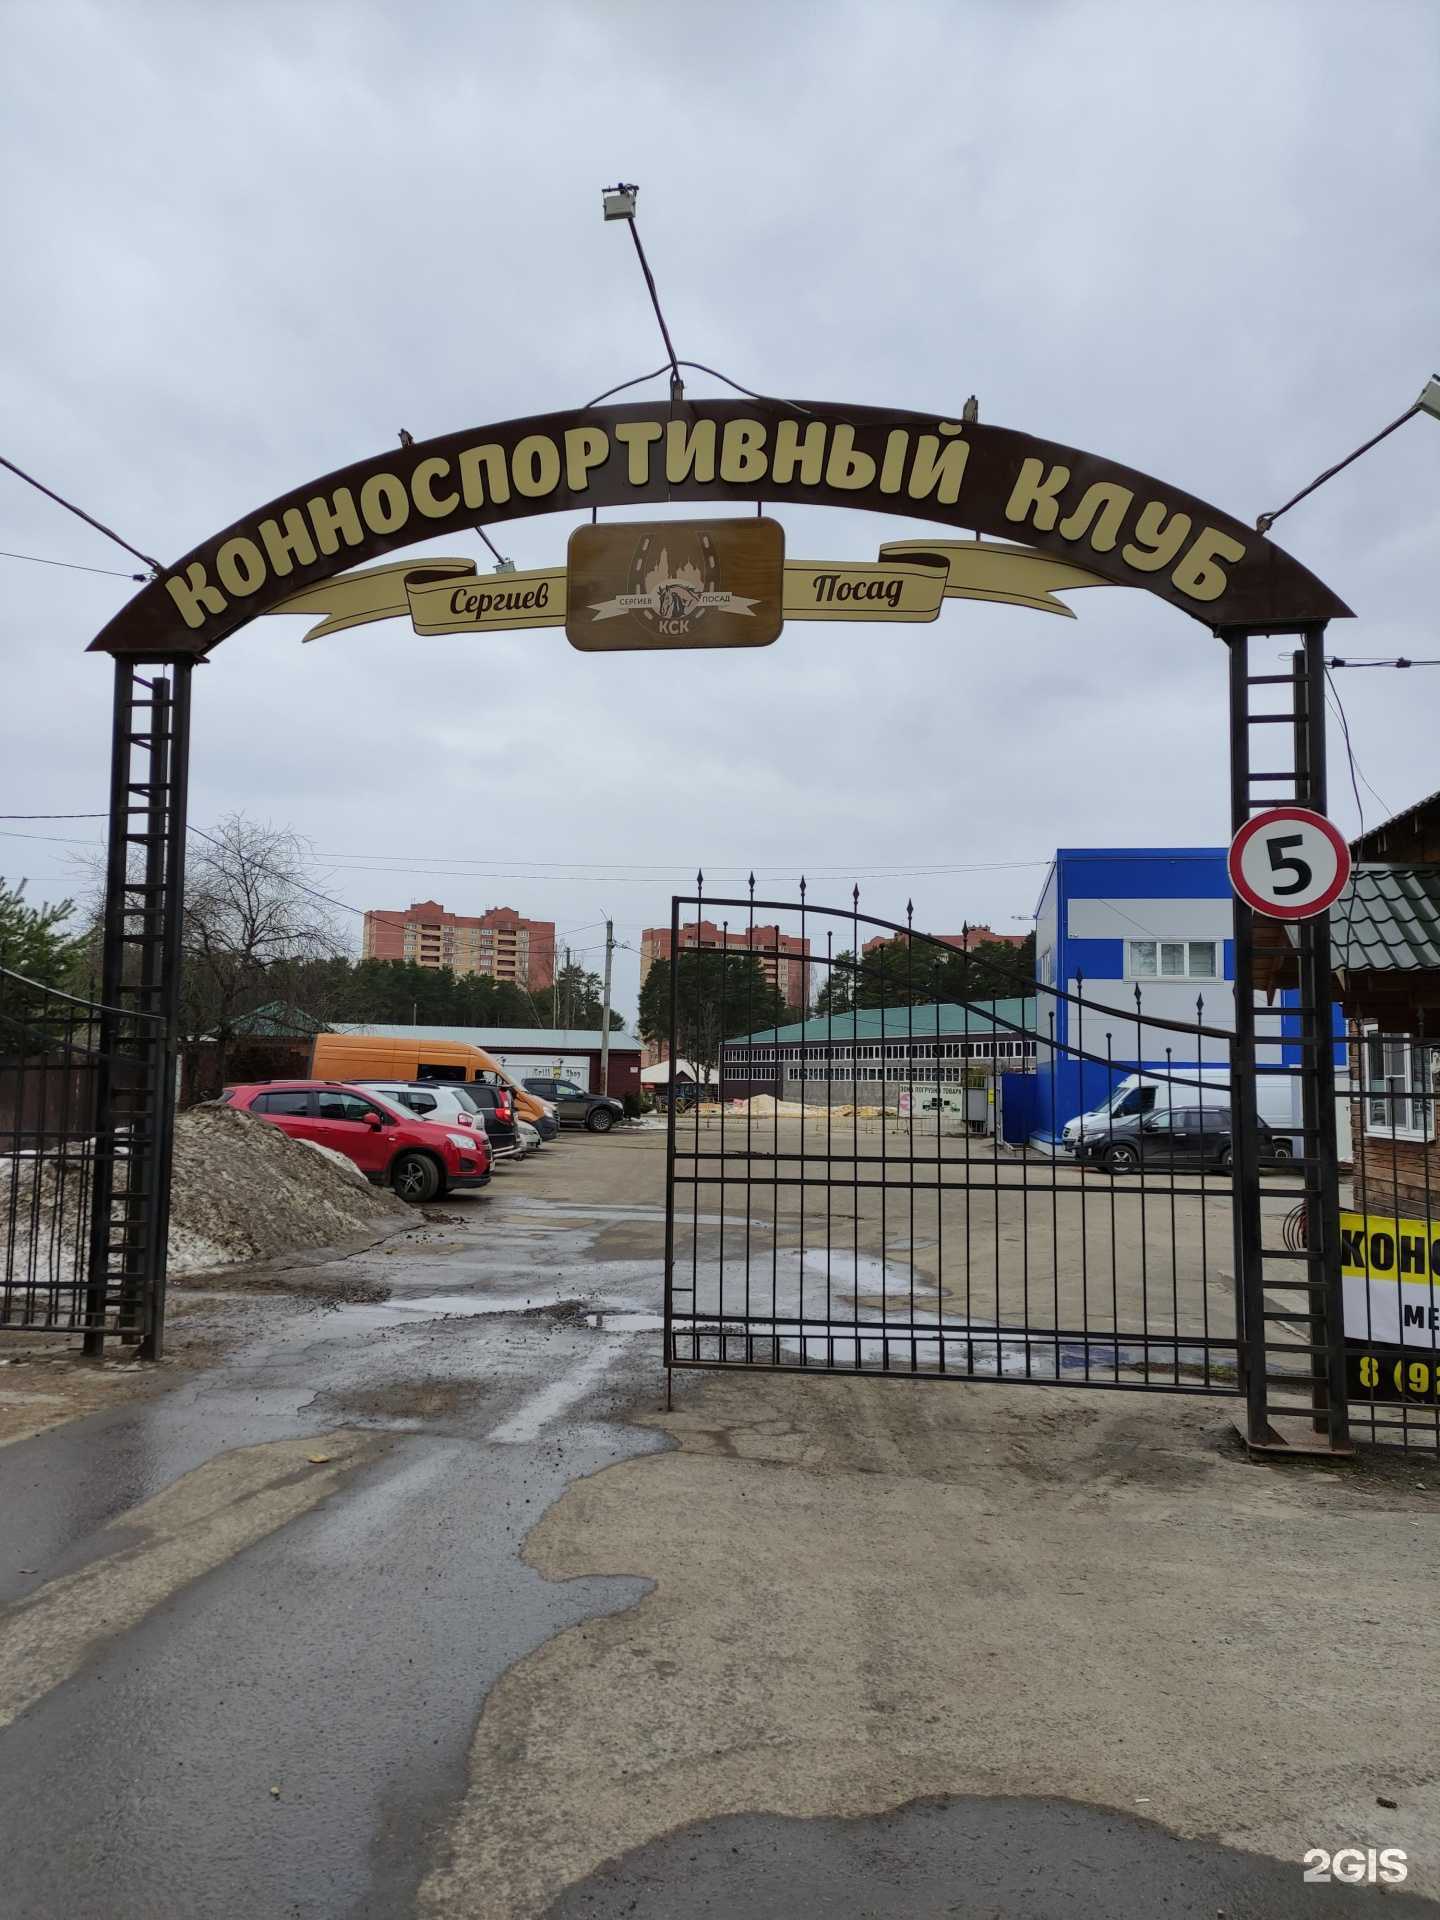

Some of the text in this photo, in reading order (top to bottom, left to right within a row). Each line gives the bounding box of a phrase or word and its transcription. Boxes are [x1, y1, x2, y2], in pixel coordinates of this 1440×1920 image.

[164, 418, 1247, 630] КОННОСПОРТИВНЫЙ КЛУБ
[450, 574, 904, 620] Сергиев Посад
[702, 595, 730, 603] ПОСАД
[659, 620, 690, 635] КСК
[1266, 834, 1312, 895] 5
[915, 1086, 940, 1094] ПОГРУЗК
[1360, 1356, 1440, 1396] 8 (9
